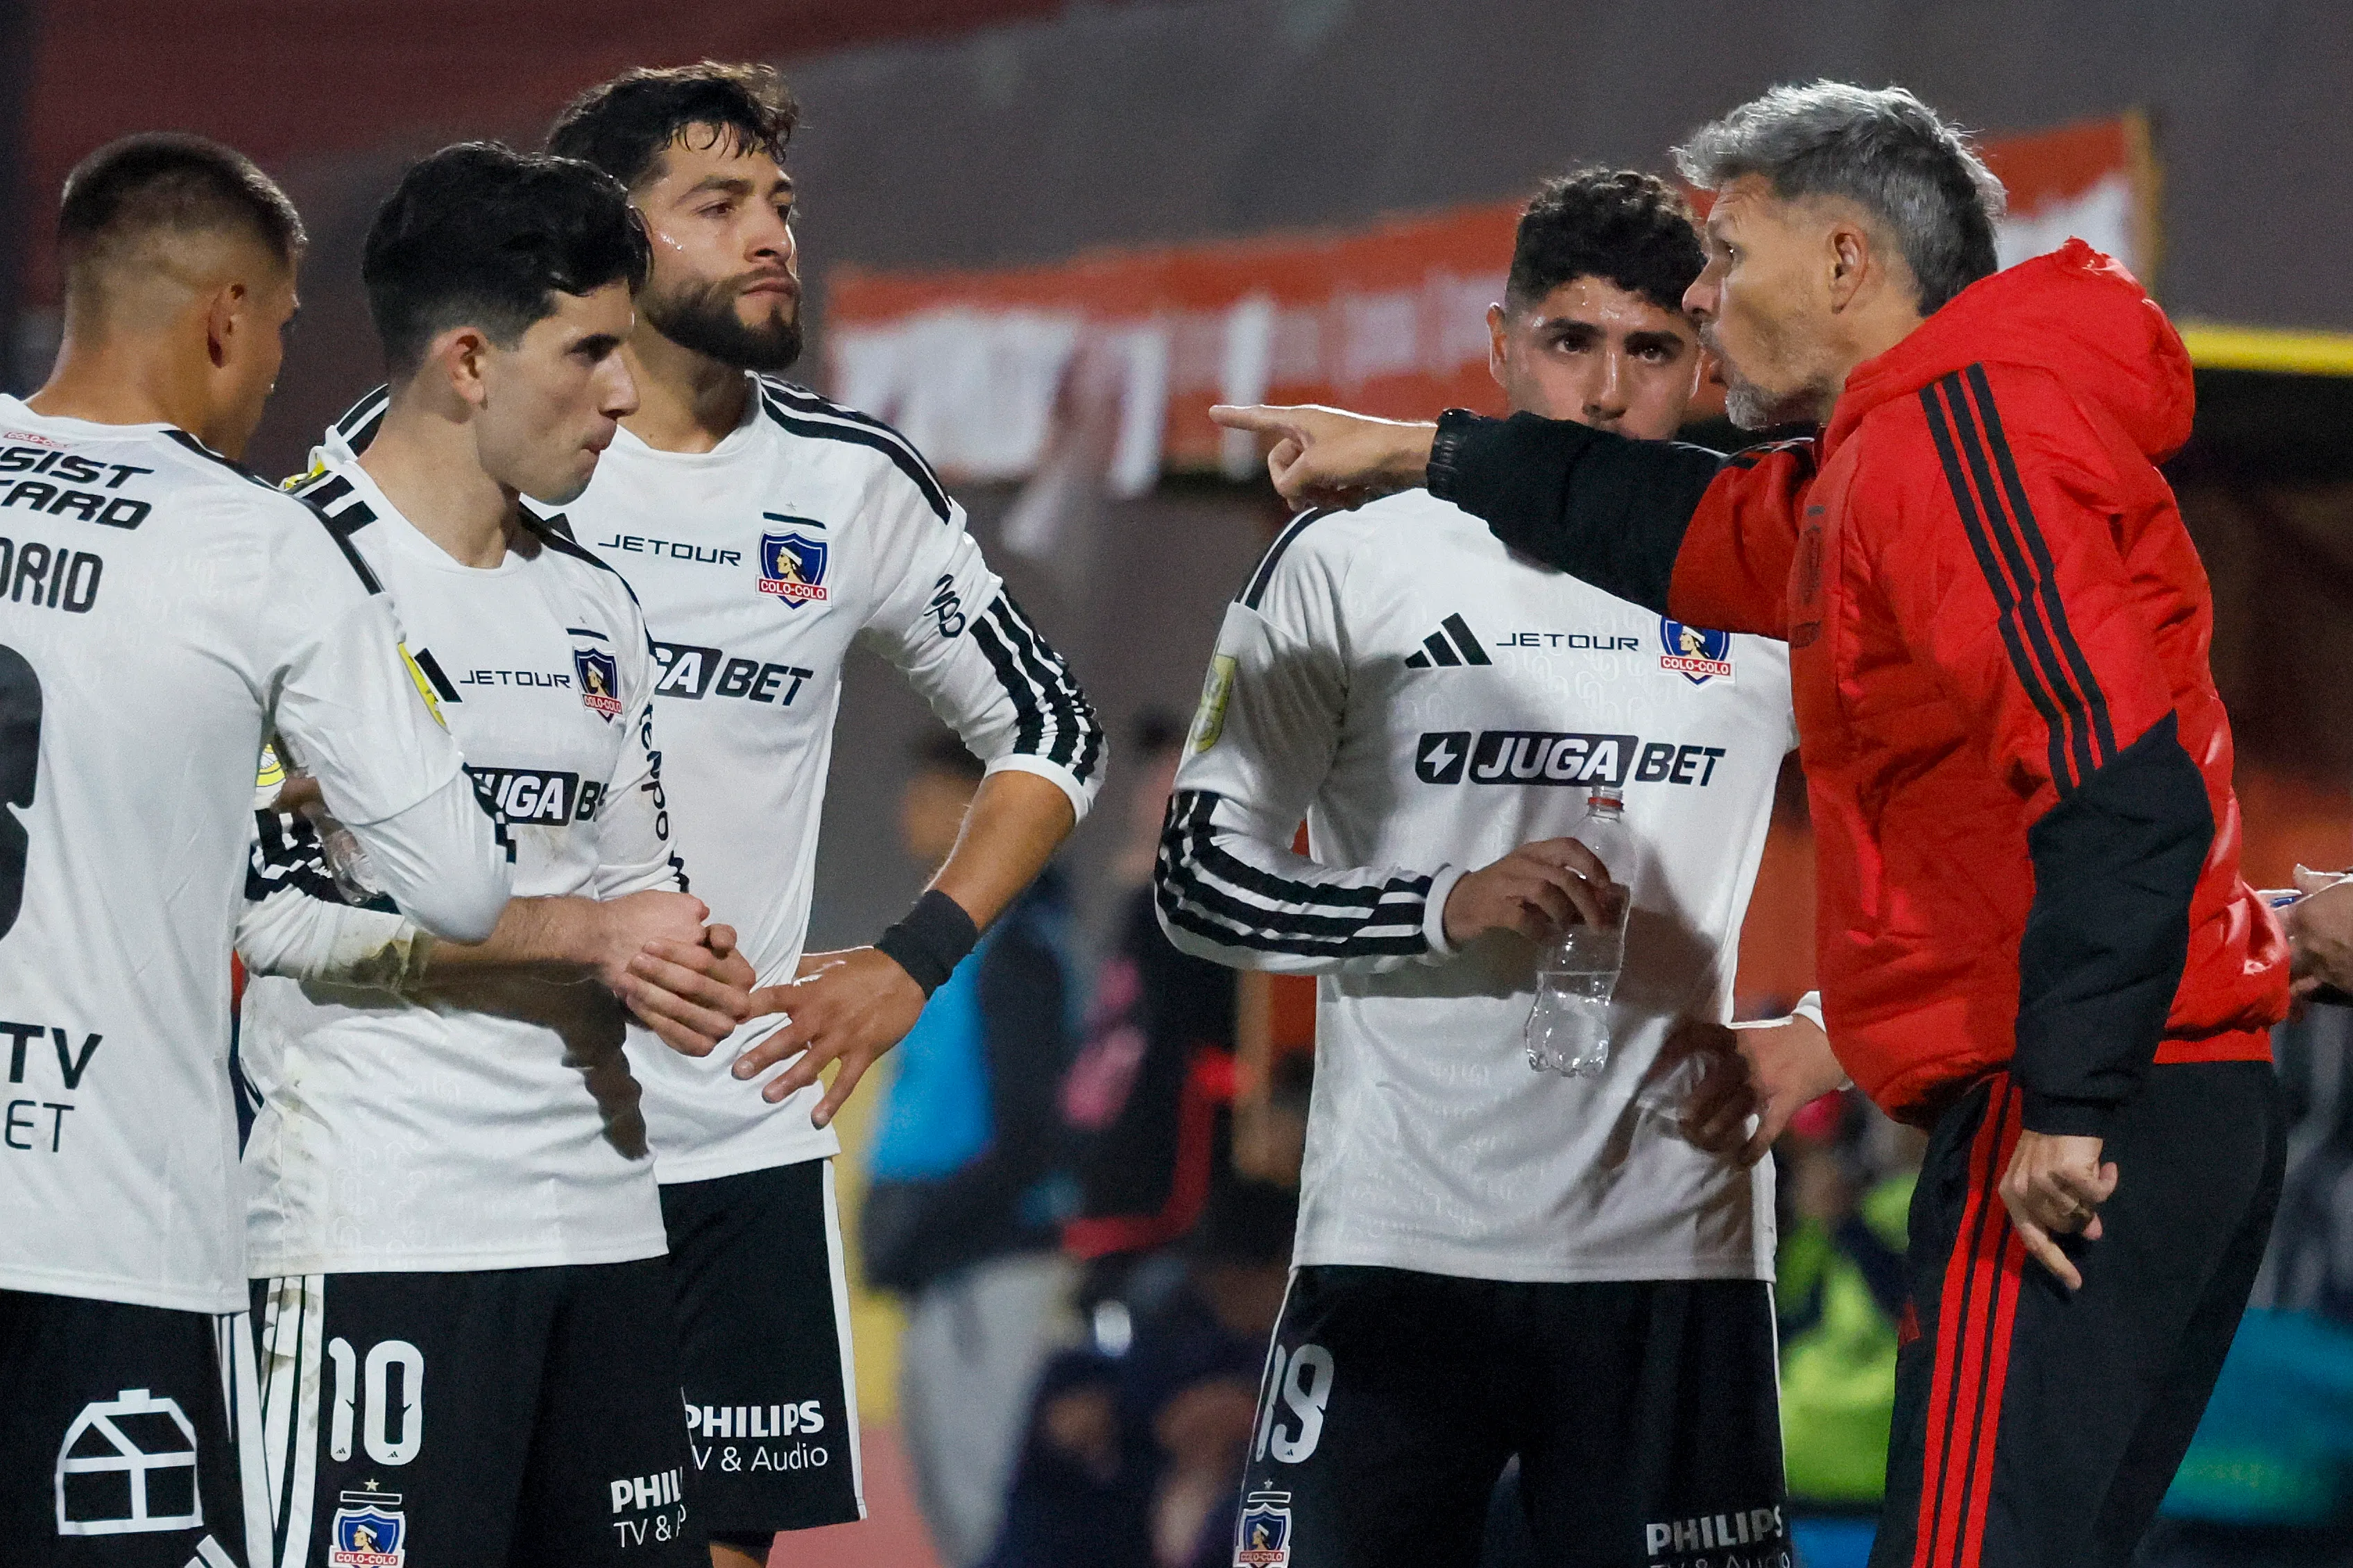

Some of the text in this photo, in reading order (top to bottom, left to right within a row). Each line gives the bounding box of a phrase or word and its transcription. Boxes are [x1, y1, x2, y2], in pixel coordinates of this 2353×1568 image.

[0, 447, 154, 488] SIST
[598, 533, 741, 567] JETOUR
[760, 578, 825, 599] COLO-COLO
[1496, 632, 1640, 652] JETOUR
[1662, 656, 1729, 675] COLO-COLO
[460, 670, 572, 689] JETOUR
[584, 695, 622, 714] COLO-COLO
[328, 1336, 425, 1466] 10
[1256, 1343, 1335, 1464] 19
[691, 1442, 829, 1472] V & Audio
[610, 1466, 683, 1514] PHIL
[613, 1517, 648, 1548] TV
[656, 1515, 671, 1542] &
[335, 1552, 397, 1565] COLO-COLO
[1240, 1552, 1283, 1564] COLO-COLO
